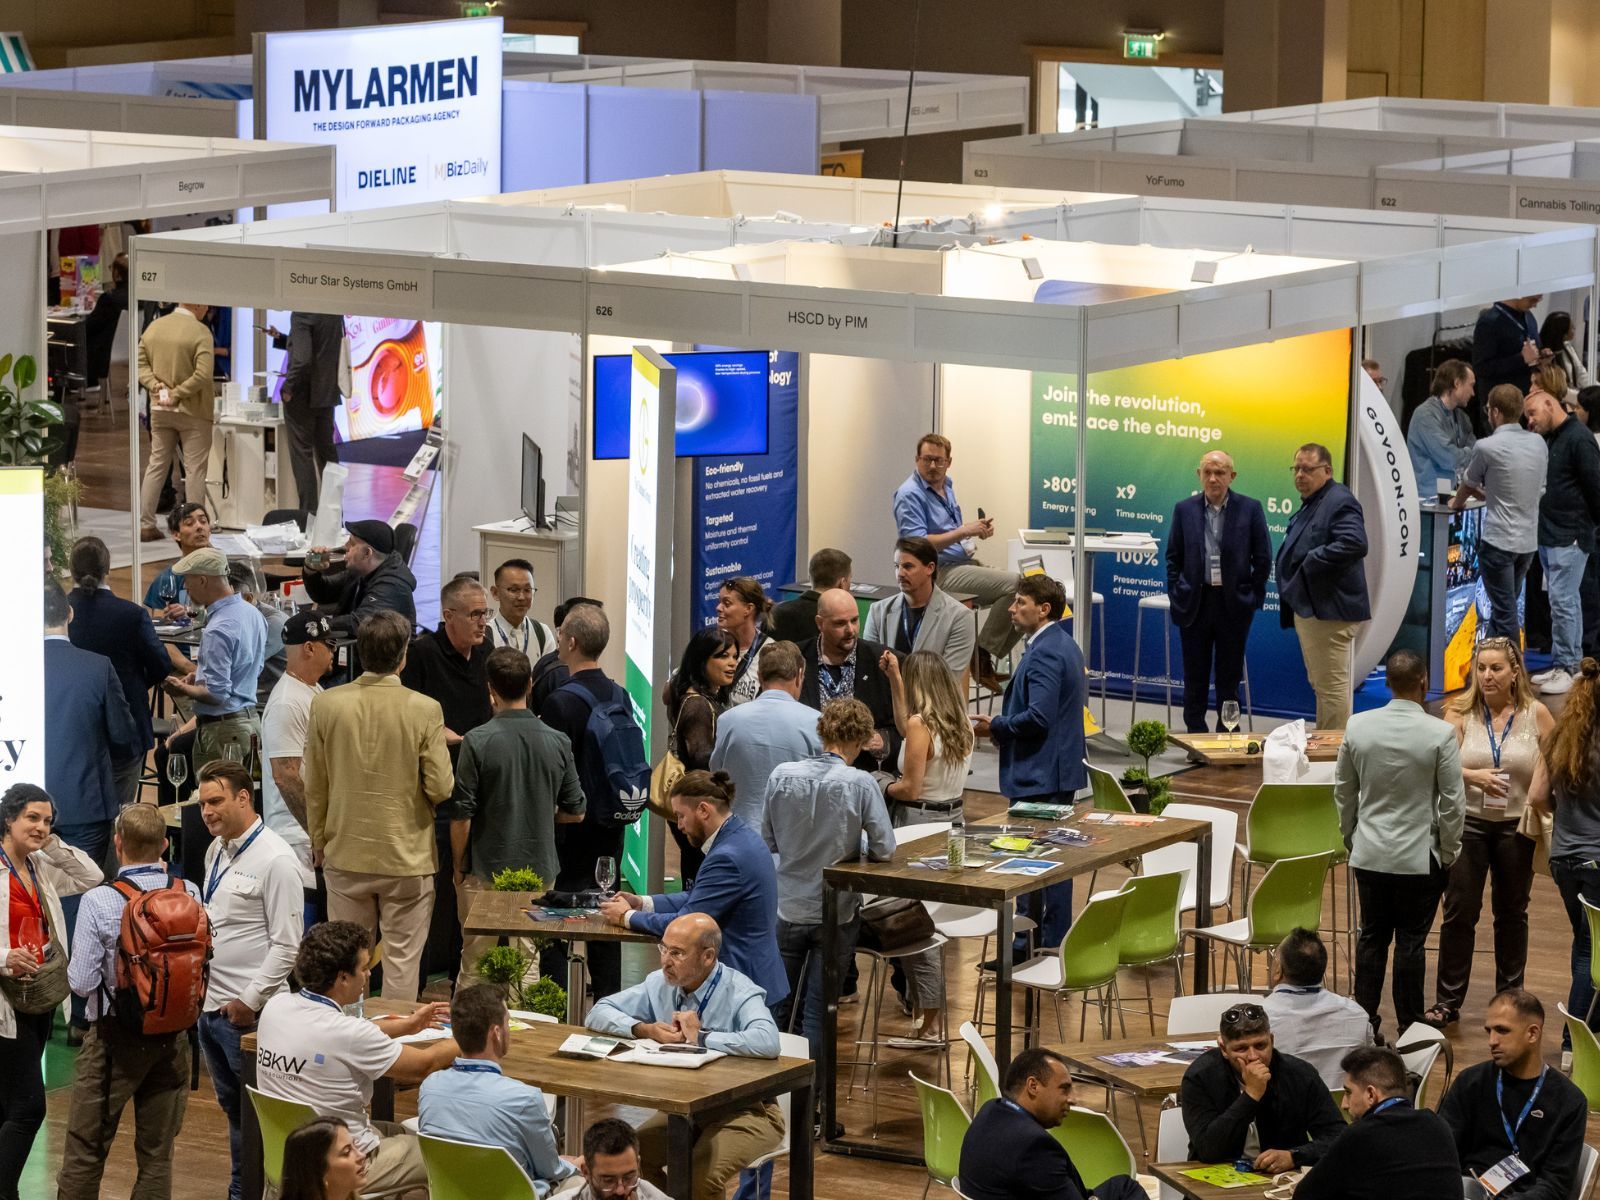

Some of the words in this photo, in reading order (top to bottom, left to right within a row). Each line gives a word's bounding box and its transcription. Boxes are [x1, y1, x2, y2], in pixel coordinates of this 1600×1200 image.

[294, 55, 478, 112] MYLARMEN
[313, 122, 327, 132] THE
[328, 121, 355, 131] DESIGN
[356, 118, 390, 129] FORWARD
[392, 113, 432, 126] PACKAGING
[433, 109, 460, 121] AGENCY
[434, 158, 488, 180] MJBizDaily
[974, 169, 989, 178] 623
[358, 166, 416, 189] DIELINE
[1145, 175, 1185, 187] YoFumo
[178, 181, 205, 193] Begrow
[1381, 197, 1397, 207] 622
[1519, 197, 1566, 210] Cannabis
[1570, 200, 1600, 214] Tolling
[141, 271, 157, 282] 627
[290, 272, 318, 285] Schur
[320, 275, 340, 286] Star
[343, 276, 384, 290] Systems
[387, 280, 418, 291] GmbH
[595, 306, 613, 317] 626
[788, 311, 824, 326] HSCD
[828, 314, 842, 329] by
[845, 316, 868, 329] PIM
[1115, 395, 1206, 417] revolution,
[1042, 412, 1119, 431] embace
[1123, 417, 1151, 434] the
[1155, 420, 1222, 443] change
[705, 461, 744, 476] Eco-friendly
[705, 482, 713, 490] No
[773, 469, 784, 478] and
[1366, 406, 1409, 558] GOVOON.COM
[1115, 484, 1136, 499] x9
[1042, 501, 1069, 513] Energy
[1267, 496, 1293, 514] 5.0
[705, 511, 734, 526] Targeted
[1115, 509, 1135, 519] Time
[1136, 511, 1164, 523] saving
[727, 526, 737, 535] and
[1115, 551, 1159, 566] 100%
[705, 561, 742, 577] Sustainable
[1113, 575, 1164, 587] Preservation
[1113, 586, 1121, 595] of
[1122, 588, 1139, 596] raw
